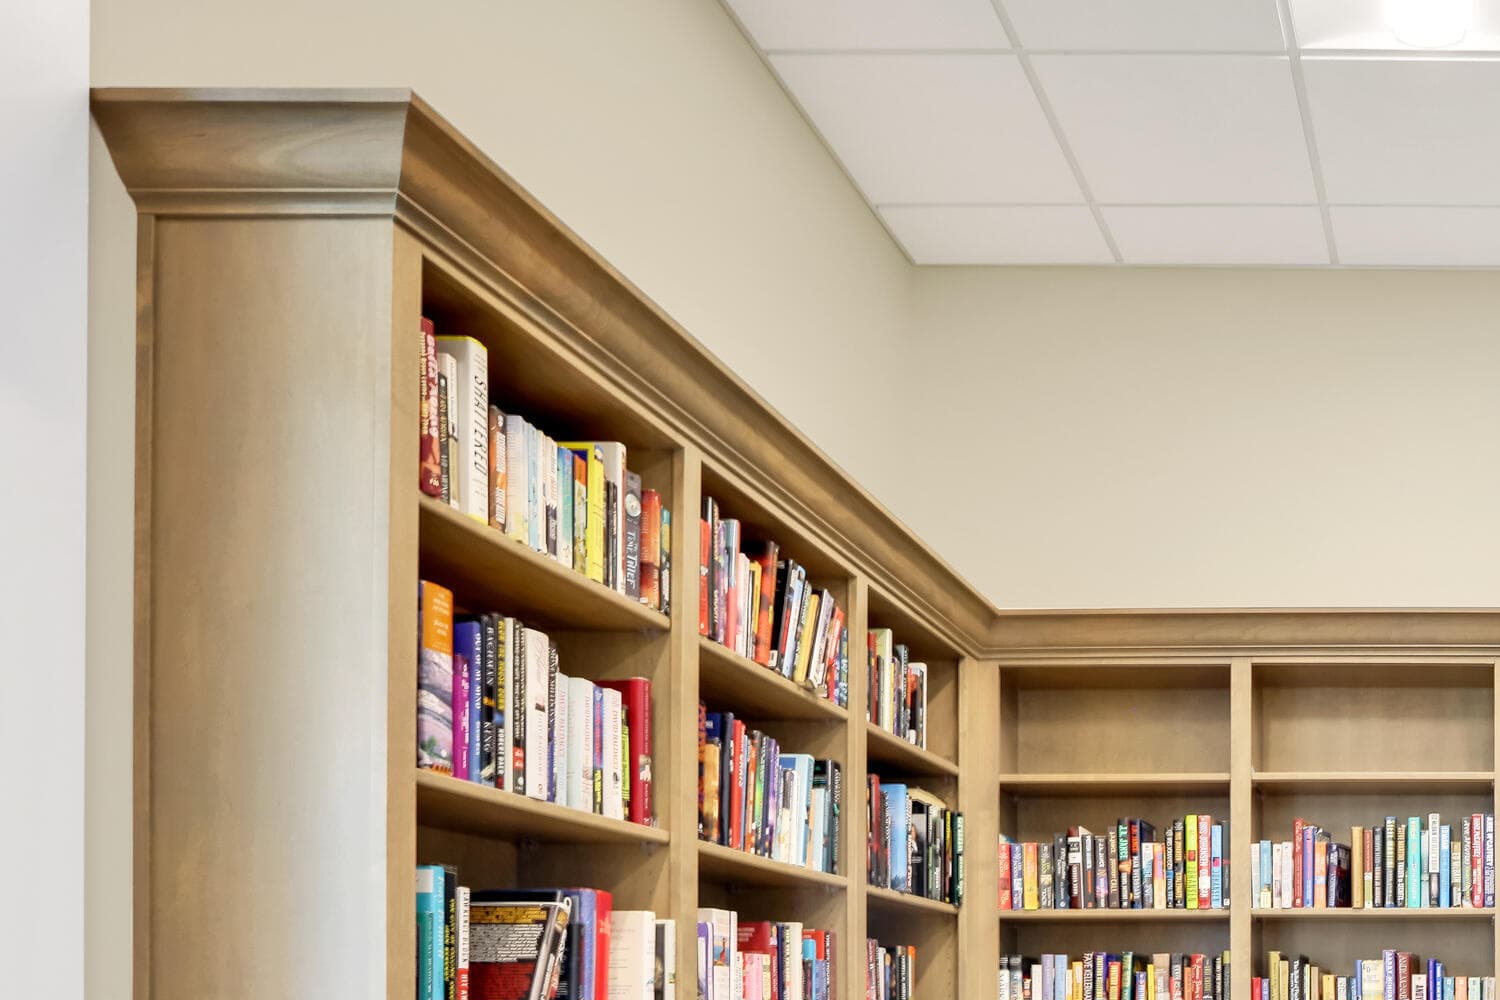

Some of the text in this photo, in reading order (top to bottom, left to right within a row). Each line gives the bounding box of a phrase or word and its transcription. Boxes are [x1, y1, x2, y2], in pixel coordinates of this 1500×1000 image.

[474, 375, 488, 477] SHATTERED
[484, 626, 495, 753] BACHMAN KING
[1084, 953, 1092, 968] FAYE
[1415, 984, 1424, 1000] ANDY
